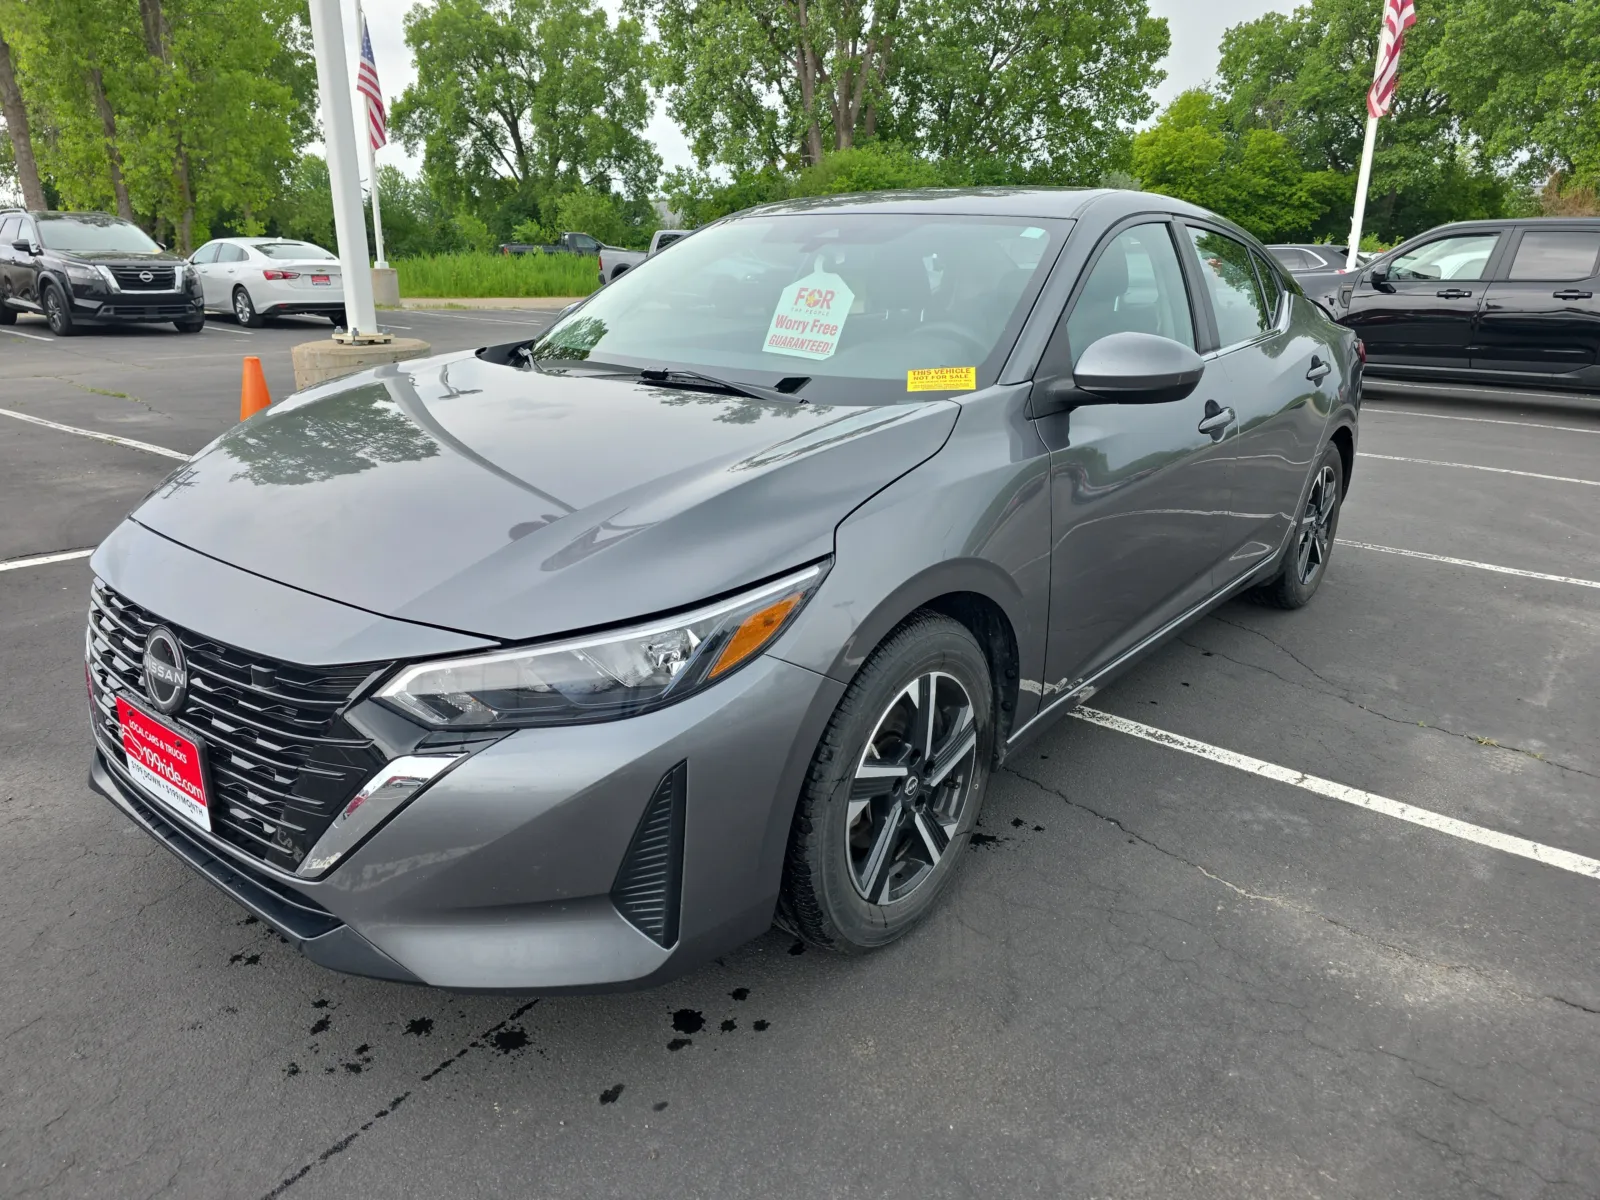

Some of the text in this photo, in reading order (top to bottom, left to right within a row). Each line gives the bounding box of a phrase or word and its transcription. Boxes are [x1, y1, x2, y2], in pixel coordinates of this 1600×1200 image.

[775, 314, 838, 336] Worry Free
[768, 334, 834, 354] GUARANTEED!
[933, 367, 971, 375] VEHICLE
[144, 654, 184, 685] NISSAN
[129, 720, 188, 764] LOCAL CARS & TRUCKS
